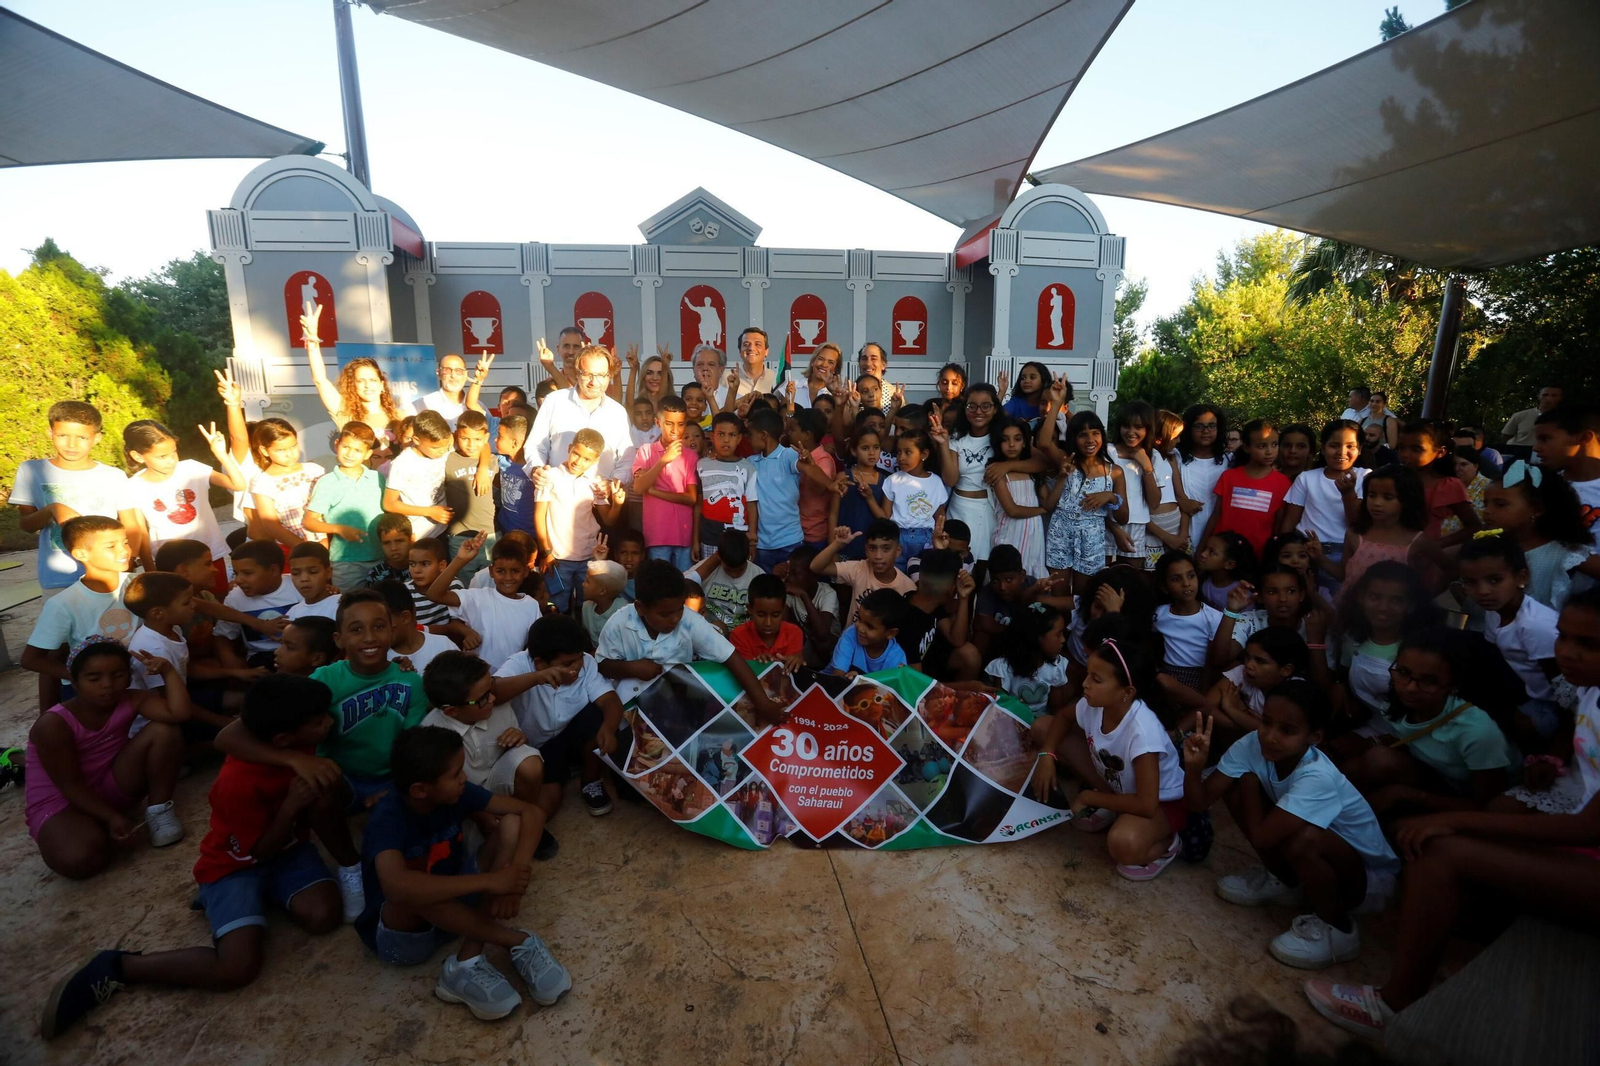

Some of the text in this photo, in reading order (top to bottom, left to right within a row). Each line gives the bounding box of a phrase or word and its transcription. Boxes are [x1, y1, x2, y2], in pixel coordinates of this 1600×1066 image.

[708, 584, 749, 604] BEAC
[793, 716, 816, 728] 1994
[823, 723, 849, 731] 2024
[770, 728, 874, 762] 30 años
[769, 758, 874, 780] Comprometidos
[788, 784, 854, 798] con el pueblo
[797, 796, 843, 809] Saharaui
